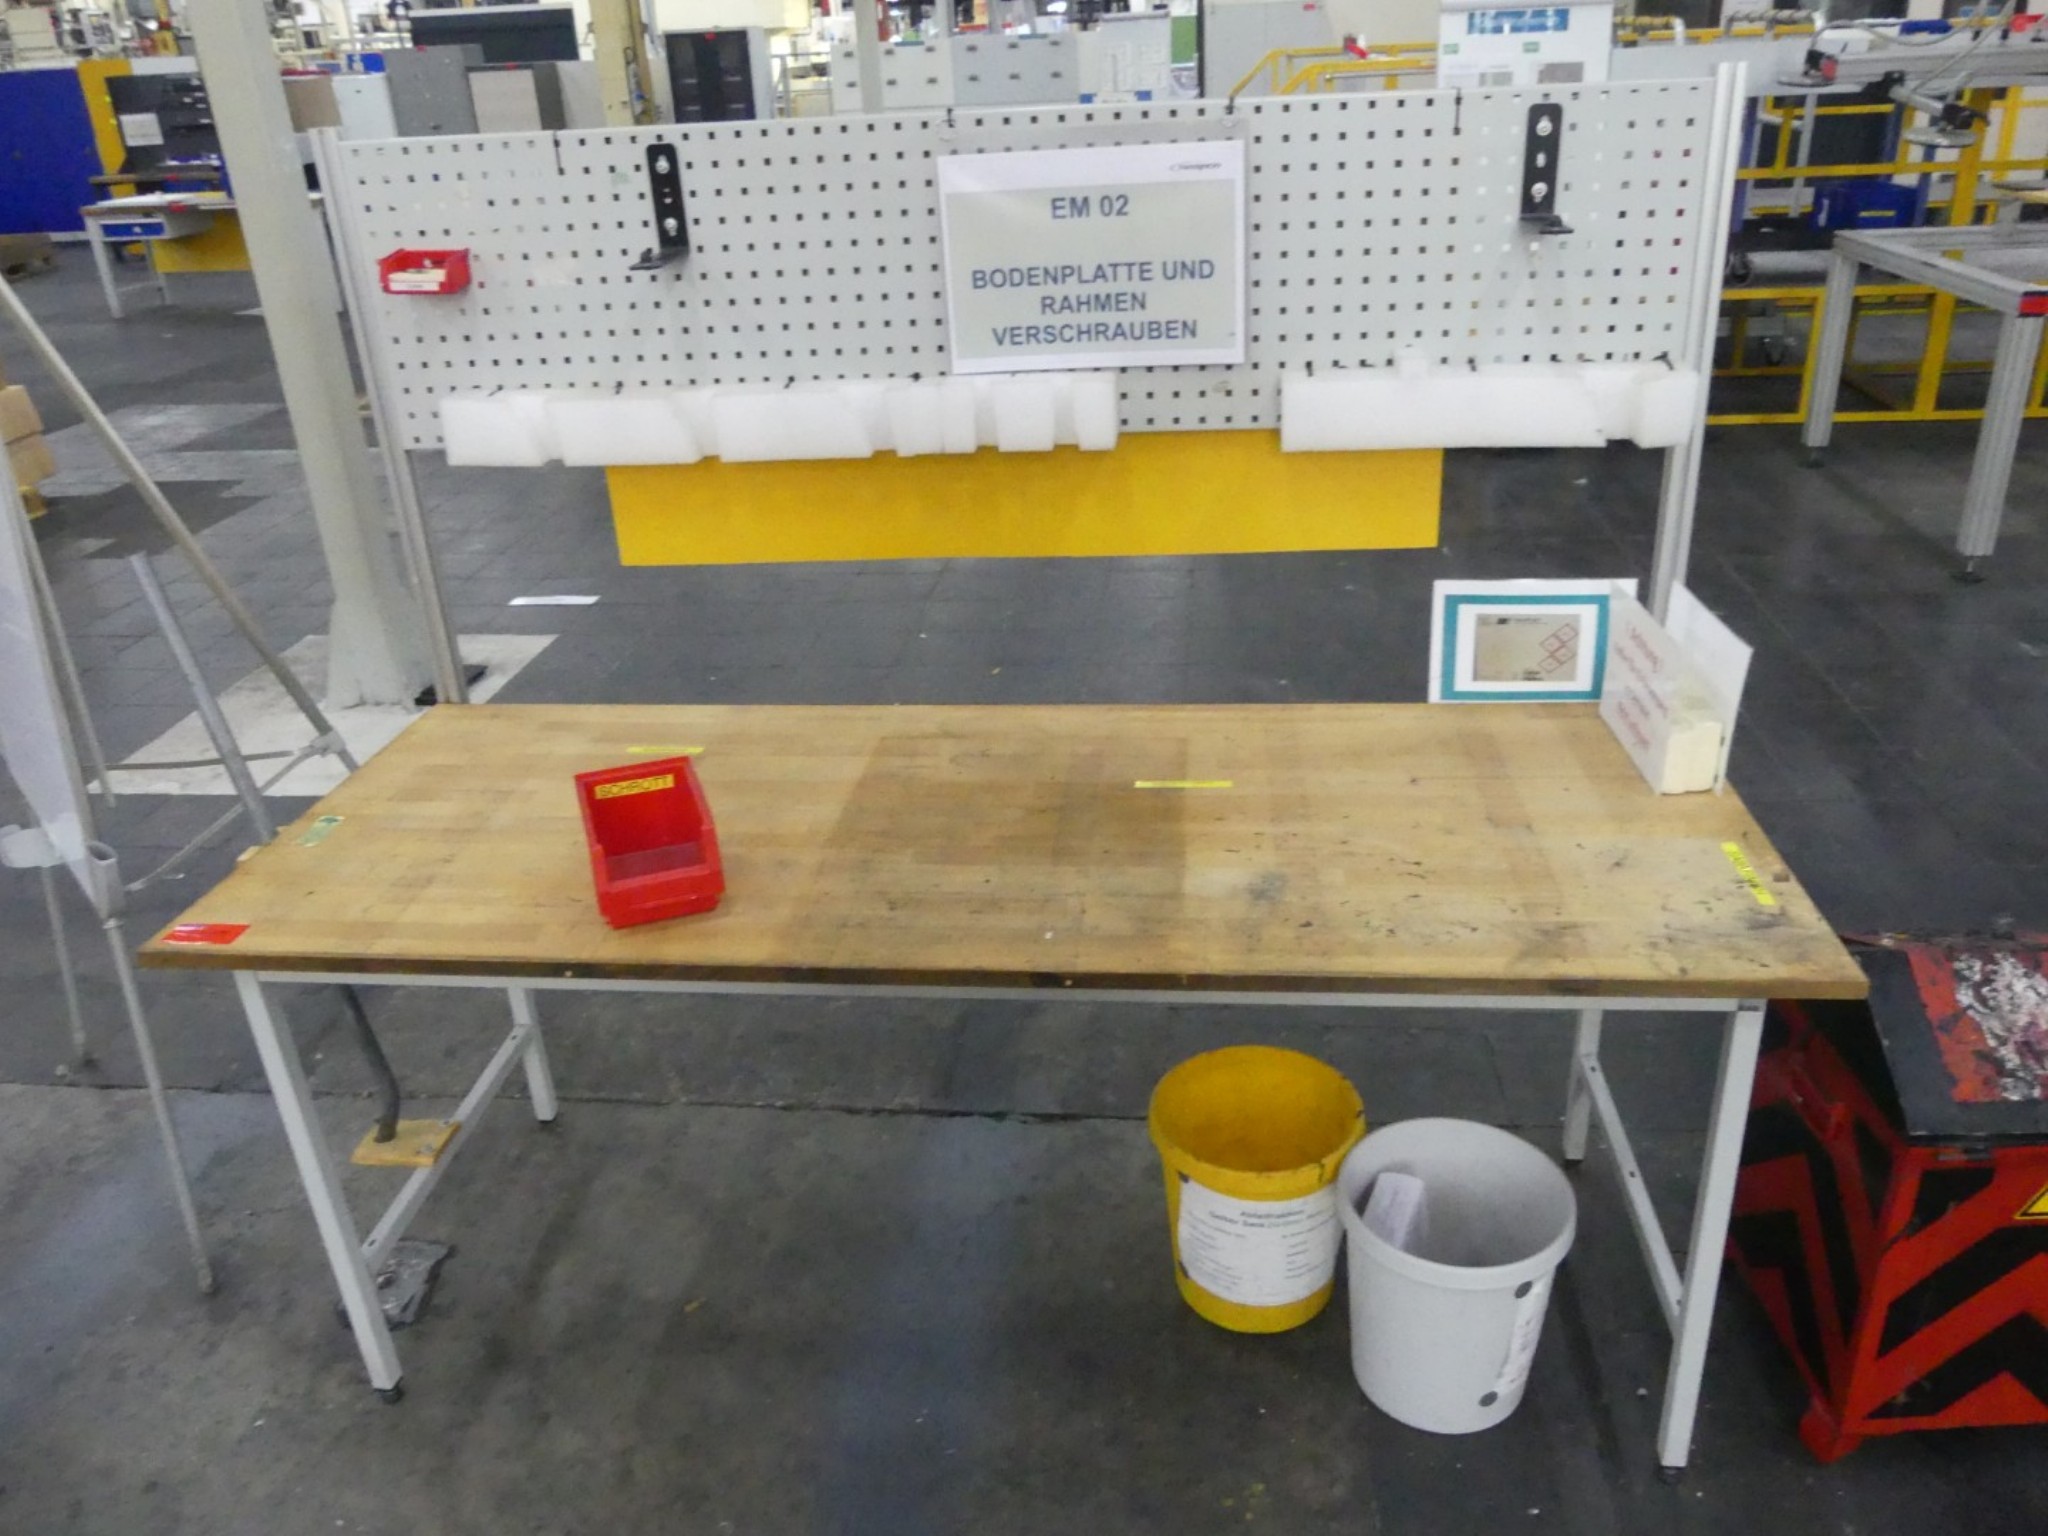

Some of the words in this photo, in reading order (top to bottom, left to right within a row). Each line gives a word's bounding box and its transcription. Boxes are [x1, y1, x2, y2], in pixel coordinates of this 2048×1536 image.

[1050, 196, 1090, 219] EM
[1099, 194, 1130, 217] 02
[971, 261, 1153, 290] BODENPLATTE
[1161, 259, 1215, 281] UND
[1040, 292, 1147, 315] RAHMEN
[991, 319, 1198, 346] VERSCHRAUBEN
[597, 776, 670, 797] SCHROTT
